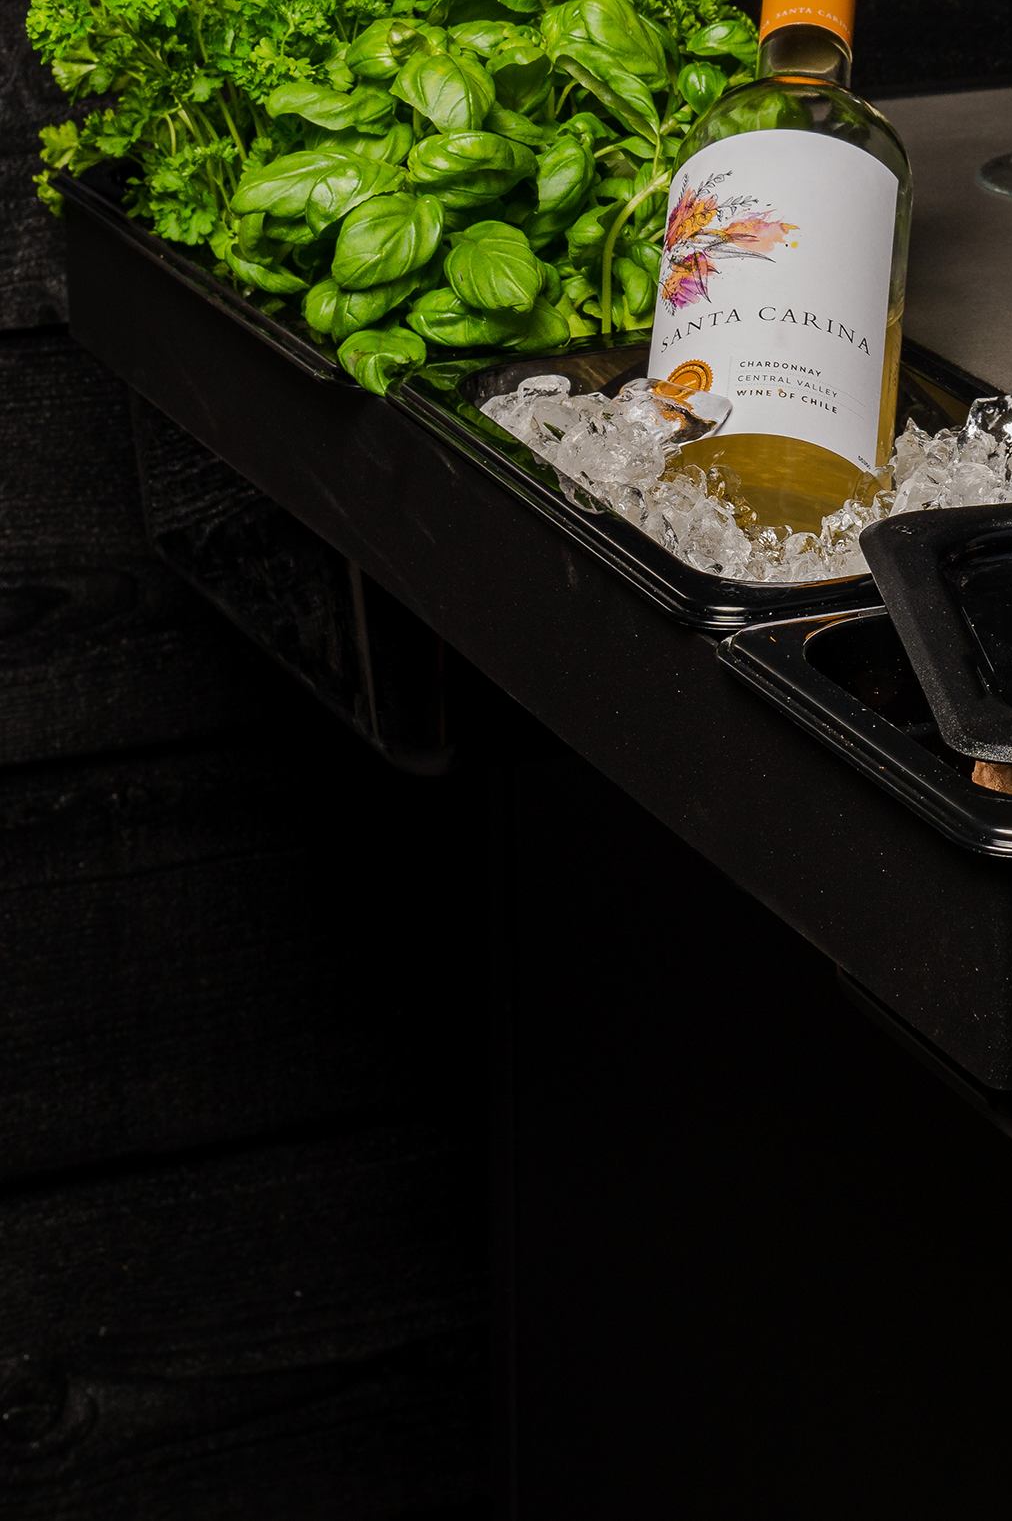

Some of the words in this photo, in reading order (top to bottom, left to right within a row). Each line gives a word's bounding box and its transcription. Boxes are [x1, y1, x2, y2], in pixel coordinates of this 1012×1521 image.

[776, 7, 813, 19] SANTA
[660, 308, 742, 353] SANTA
[758, 306, 871, 356] CARINA
[739, 360, 822, 377] CHARDONNAY
[737, 374, 792, 385] CENTRAL
[796, 379, 838, 398] VALLEY
[736, 389, 772, 397] WINE
[778, 390, 796, 400] OF
[801, 395, 838, 414] CHILE
